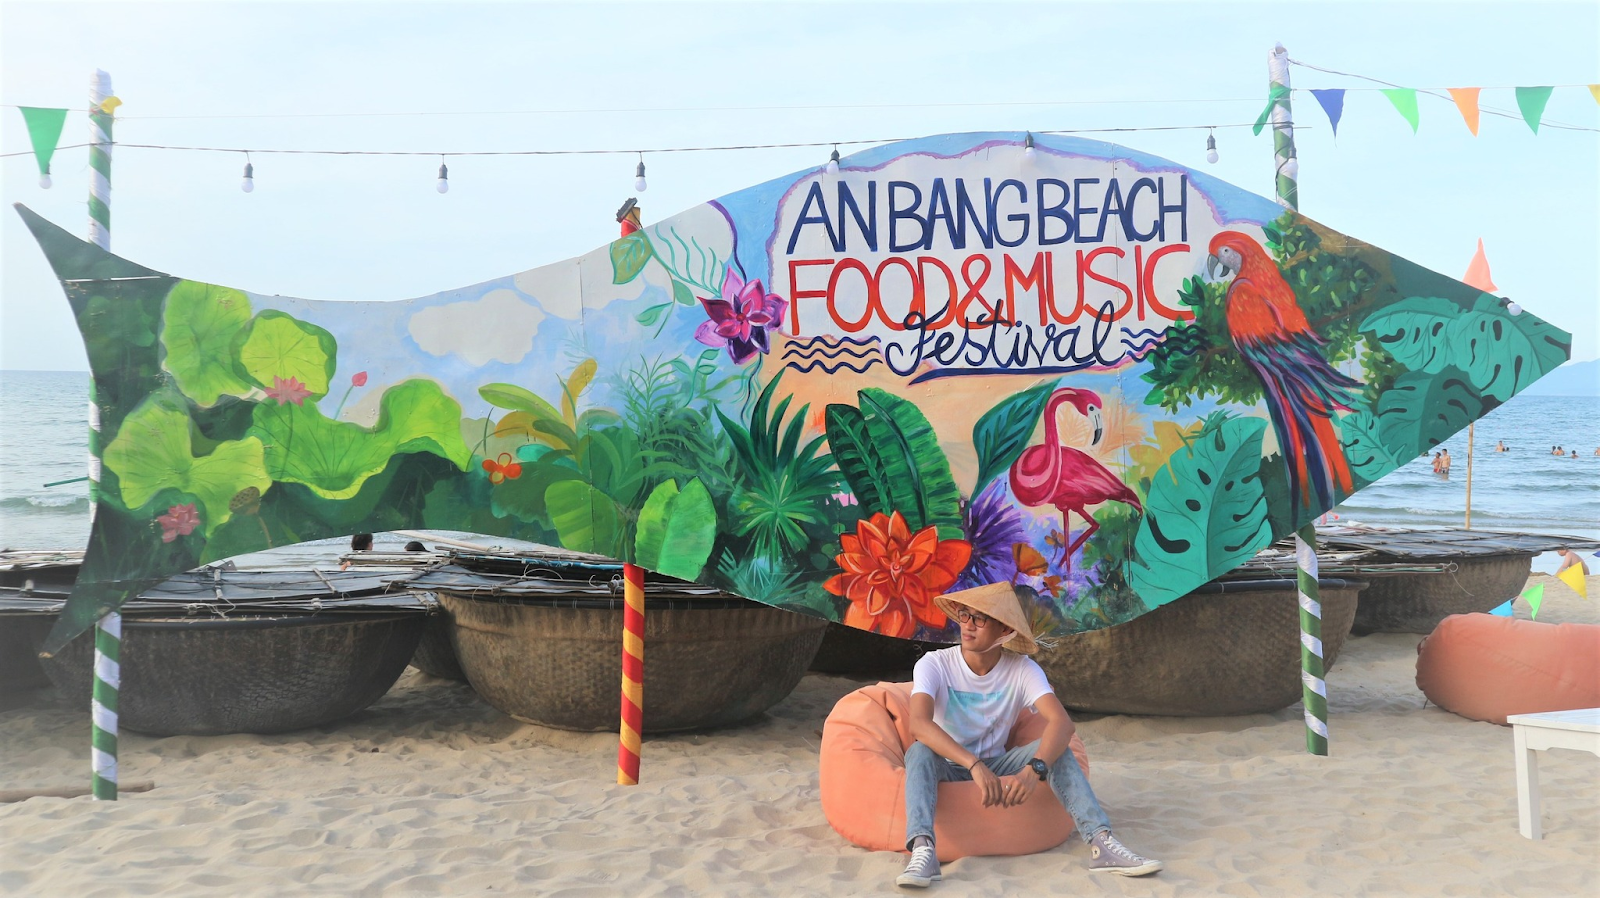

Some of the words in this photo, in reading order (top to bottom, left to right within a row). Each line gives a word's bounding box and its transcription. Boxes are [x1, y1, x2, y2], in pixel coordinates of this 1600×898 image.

[786, 180, 878, 254] AN
[887, 177, 1028, 252] BANG
[1036, 174, 1188, 246] BEACH
[885, 300, 1126, 377] Festival
